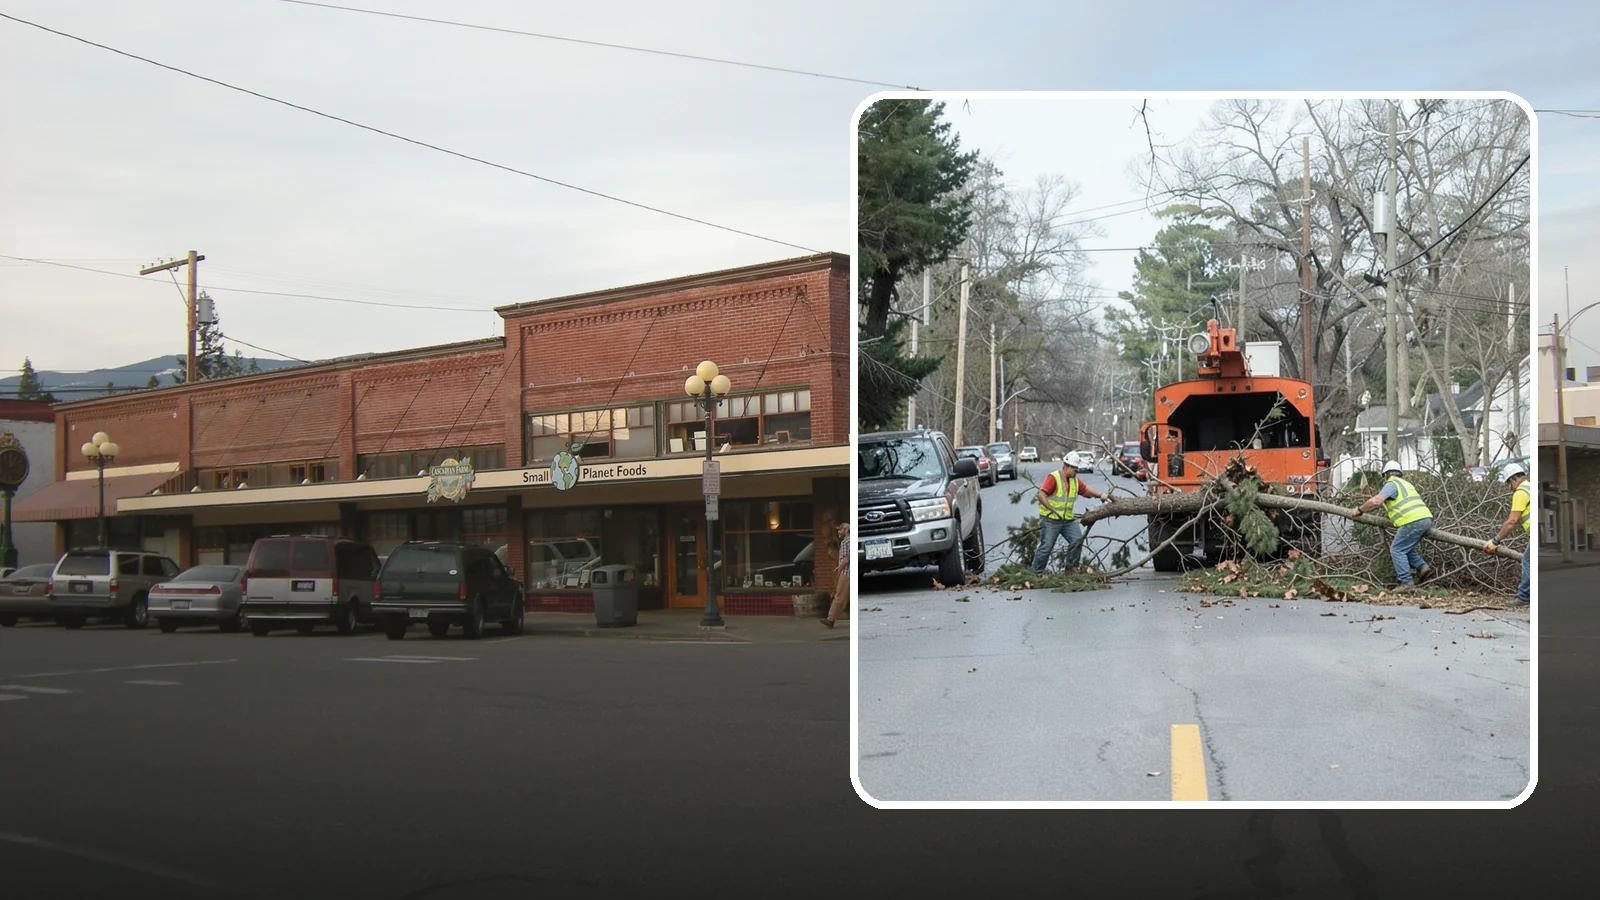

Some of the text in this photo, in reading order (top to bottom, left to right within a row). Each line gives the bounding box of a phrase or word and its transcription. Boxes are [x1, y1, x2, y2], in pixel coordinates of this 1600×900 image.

[431, 467, 455, 476] CASCADIAN
[523, 464, 647, 483] Small Planet Foods
